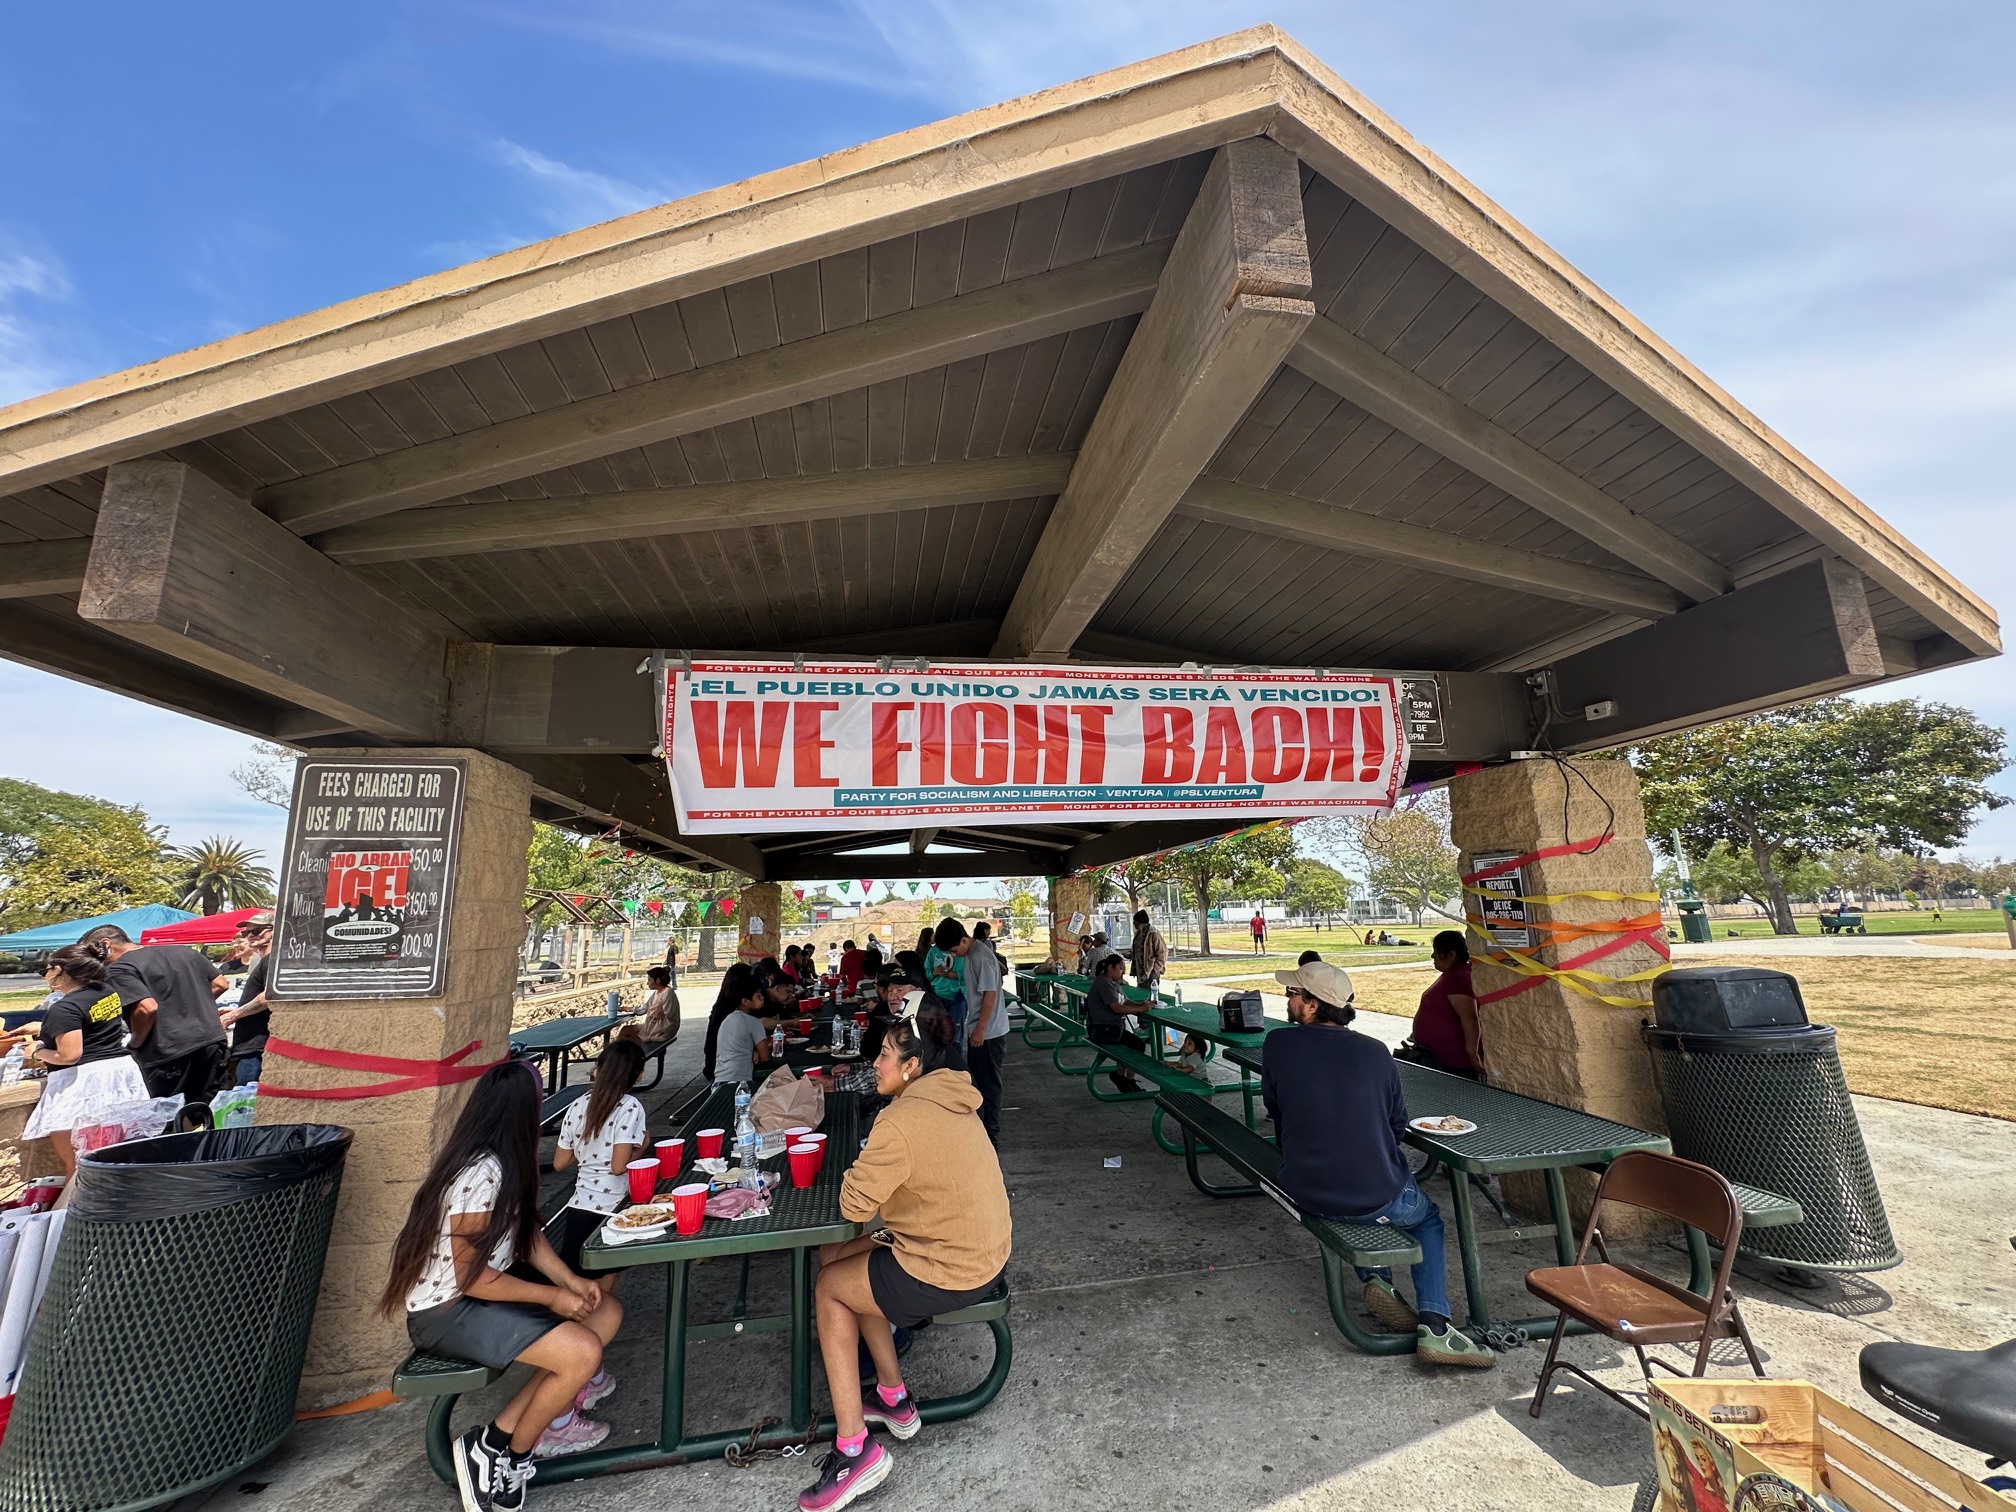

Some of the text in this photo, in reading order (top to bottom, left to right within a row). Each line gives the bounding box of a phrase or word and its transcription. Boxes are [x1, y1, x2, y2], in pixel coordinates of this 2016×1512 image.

[690, 680, 1380, 702] ¡EL PUEBLO UNIDO JAMÁS SERÁ VENCIDO!
[1401, 682, 1415, 690] OF
[667, 683, 675, 720] RIGHTS
[1412, 701, 1433, 709] 5PM
[1416, 724, 1428, 732] BE
[690, 700, 1386, 789] WE FIGHT BACK!
[318, 772, 442, 798] FEES CHARGED FOR
[841, 792, 886, 802] PARTY
[890, 791, 917, 801] FOR
[919, 790, 990, 800] SOCIALISM
[992, 789, 1020, 798] AND
[1023, 788, 1096, 798] LIBERATION
[1106, 788, 1163, 797] VENTURA
[1173, 788, 1258, 797] @PSLVENTURA
[305, 806, 445, 832] USE OF THIS FACILITY
[298, 850, 331, 873] Cleani
[360, 852, 411, 868] ABRAN
[324, 867, 409, 909] ICE!
[334, 926, 392, 937] COMUNIDADES!
[1648, 1387, 1671, 1409] LIFE
[1672, 1400, 1683, 1418] IS
